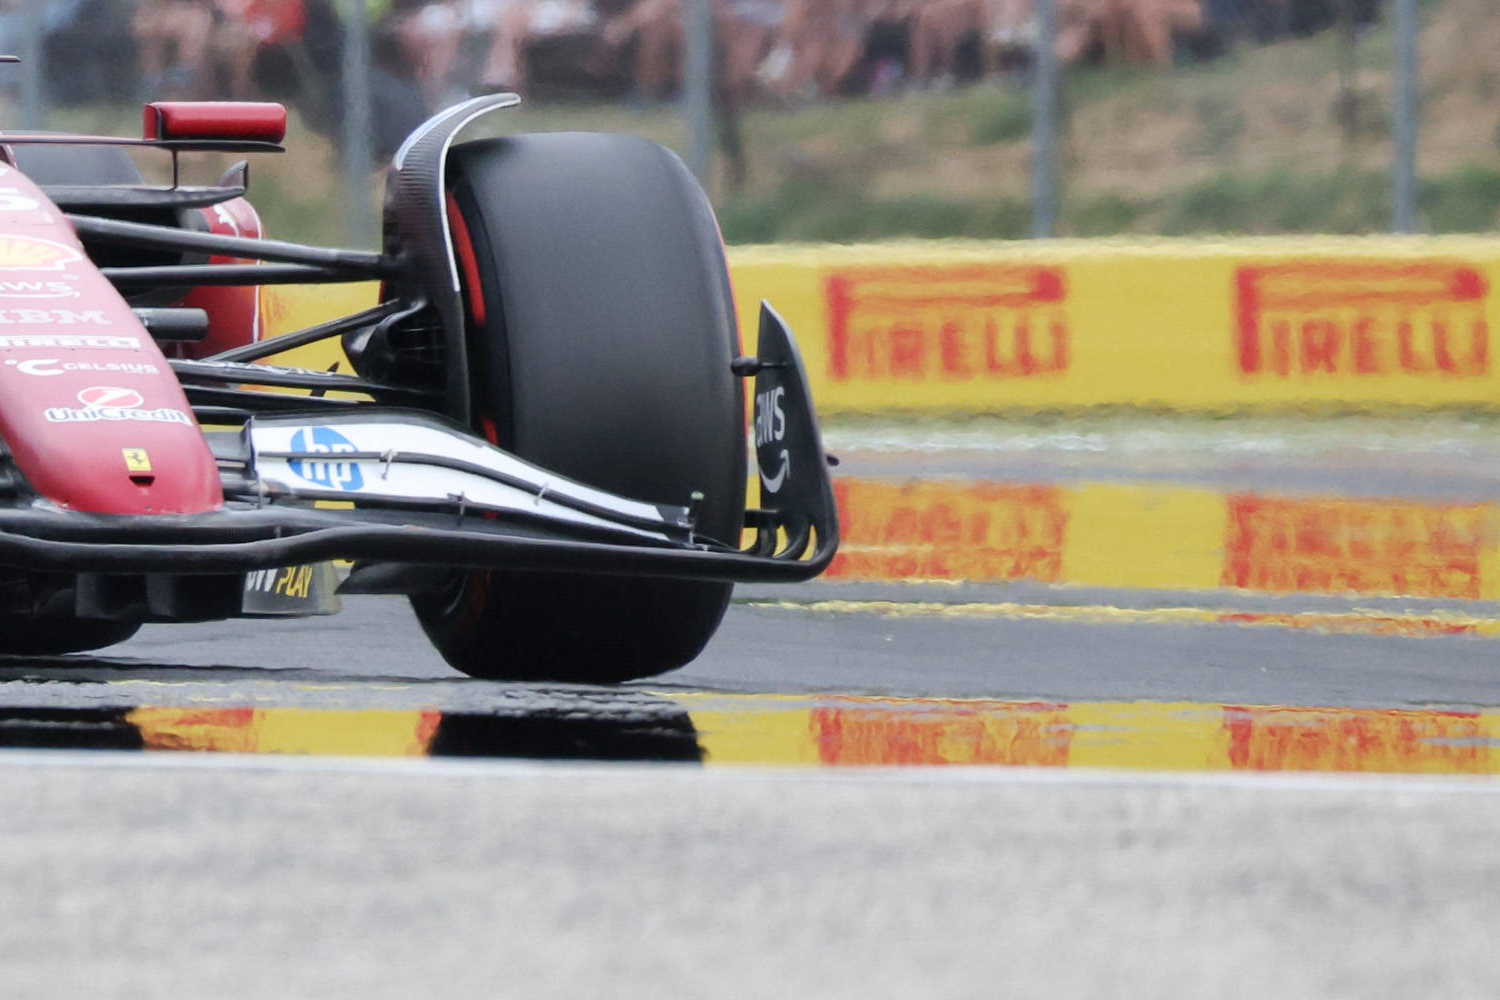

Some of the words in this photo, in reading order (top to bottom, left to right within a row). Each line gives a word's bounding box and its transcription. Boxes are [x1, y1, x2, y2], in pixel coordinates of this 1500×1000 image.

[825, 266, 1069, 379] PIRELLI
[1233, 264, 1488, 376] PIRELLI
[62, 361, 160, 374] CELSIUS
[46, 407, 191, 424] UniCredit
[301, 427, 356, 489] hp
